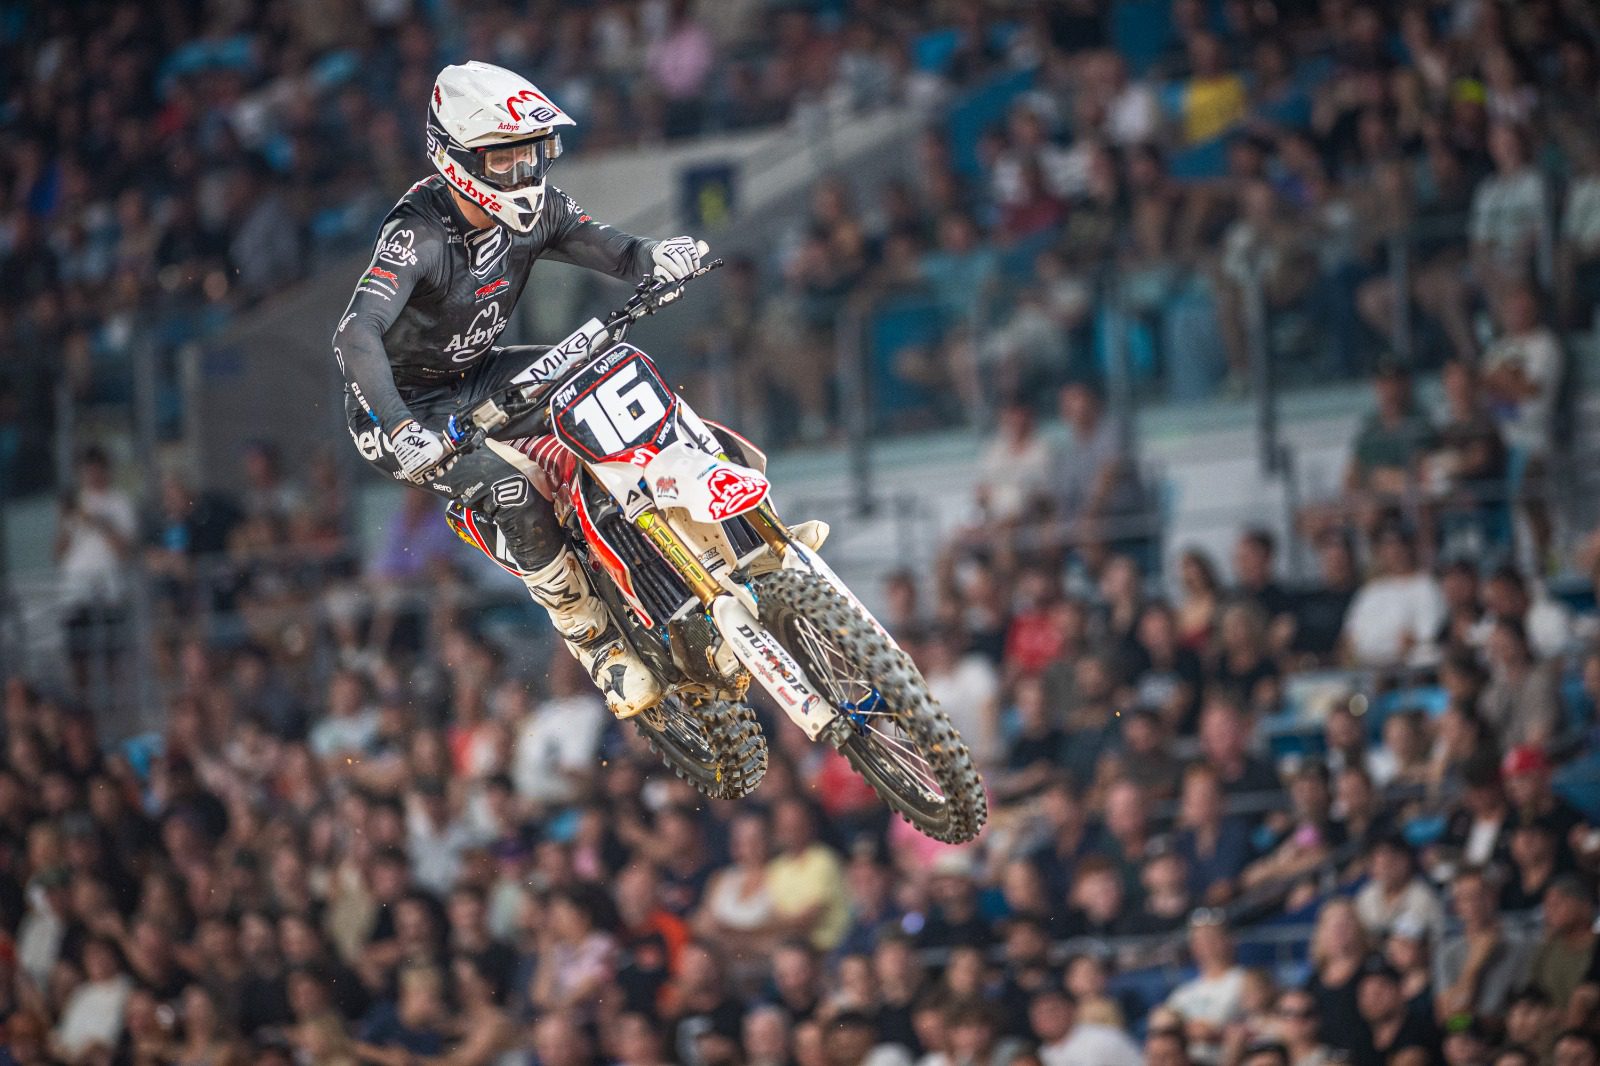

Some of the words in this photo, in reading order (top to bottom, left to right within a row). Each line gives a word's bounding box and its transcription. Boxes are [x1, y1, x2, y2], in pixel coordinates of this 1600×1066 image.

[497, 122, 520, 132] Arby's
[444, 163, 503, 213] Arby's
[379, 240, 418, 266] Arby's
[658, 288, 680, 306] ASV
[443, 316, 508, 353] Arby's
[573, 360, 667, 456] 16
[657, 421, 672, 445] LOPES
[432, 482, 453, 493] aero
[710, 476, 767, 519] Arby's
[736, 624, 810, 696] DUOP
